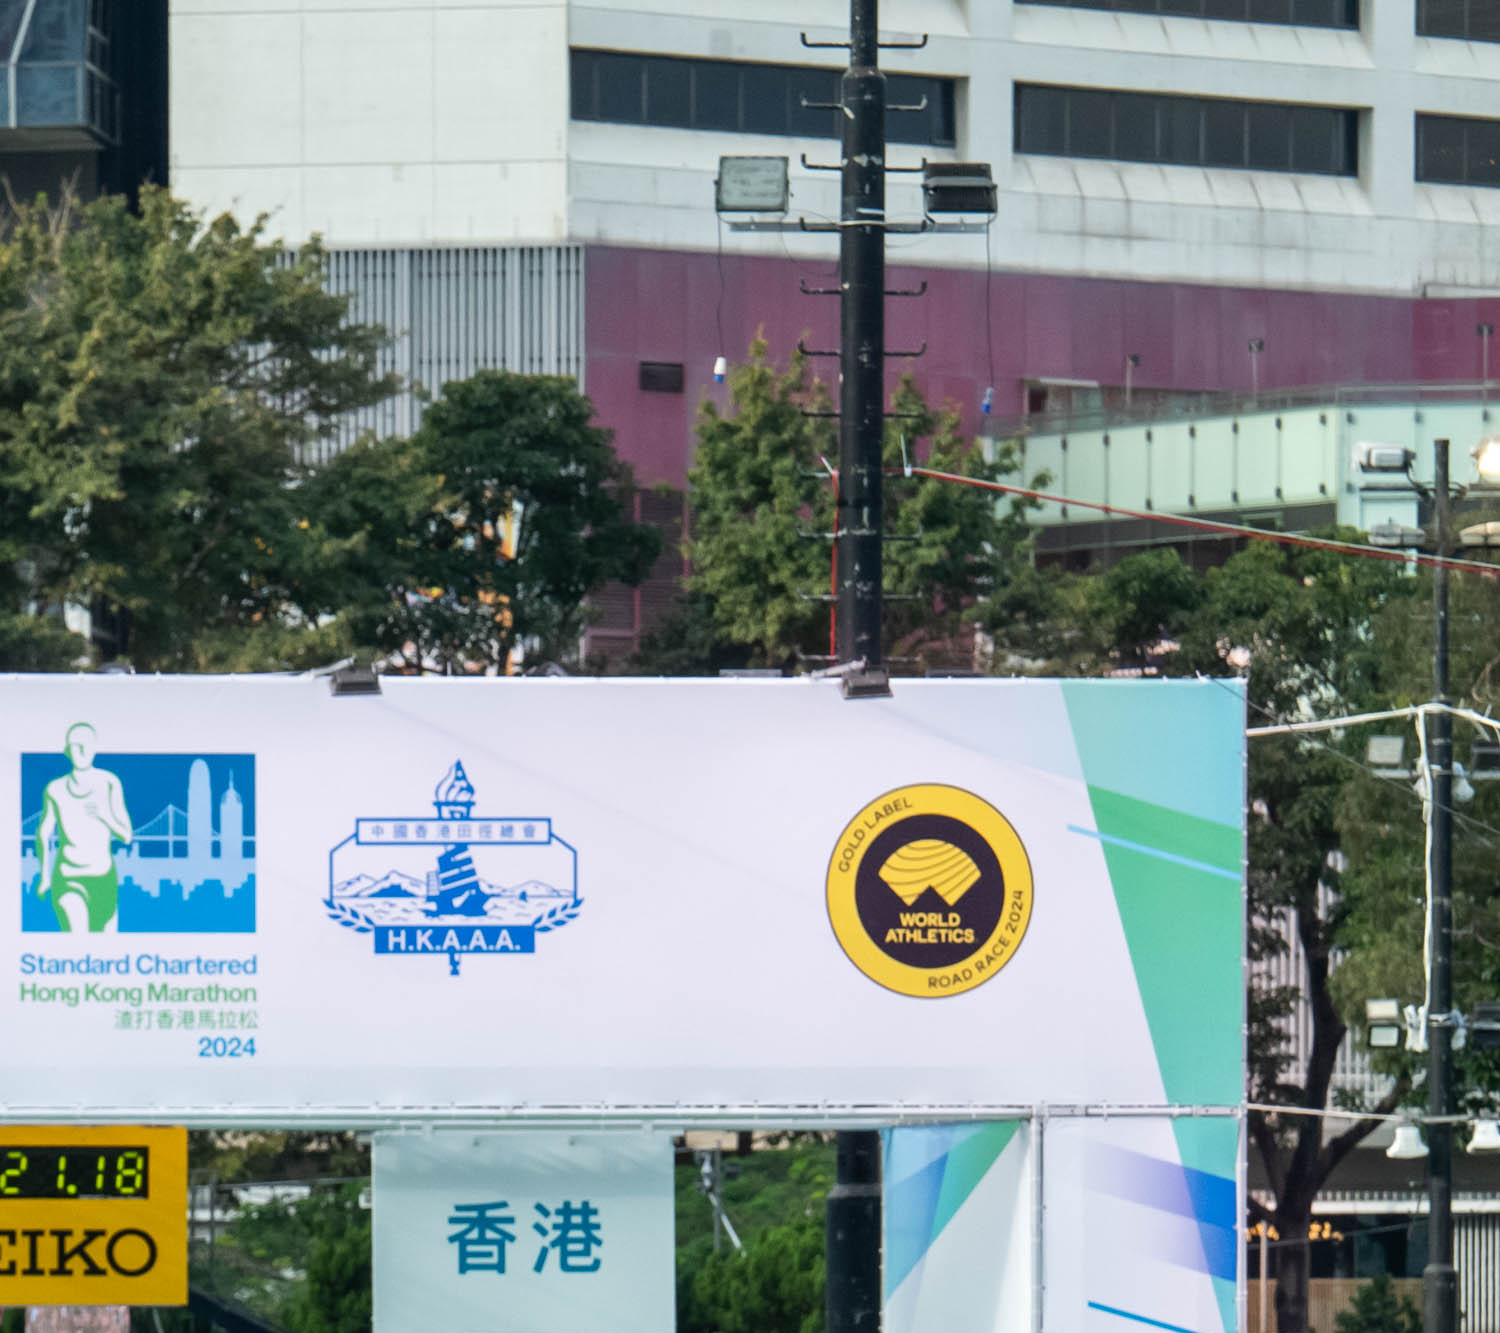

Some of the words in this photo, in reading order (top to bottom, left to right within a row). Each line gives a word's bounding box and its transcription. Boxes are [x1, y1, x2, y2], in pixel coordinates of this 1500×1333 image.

[839, 828, 865, 873] GOLD
[866, 797, 912, 829] LABEL
[900, 913, 960, 927] WORLD
[387, 930, 521, 951] H.K.A.A.A.
[885, 929, 975, 944] ATHLETICS
[928, 968, 973, 989] ROAD
[975, 936, 1010, 973] RACE
[1005, 890, 1024, 934] 2024
[20, 954, 131, 975] Standard
[136, 954, 257, 975] Chartered
[20, 983, 82, 1007] Hong
[85, 983, 143, 1007] Kong
[147, 983, 257, 1003] Marathon
[114, 1009, 259, 1031] 渣打香港馬拉松
[198, 1036, 257, 1059] 2024
[448, 1200, 602, 1274] 香港
